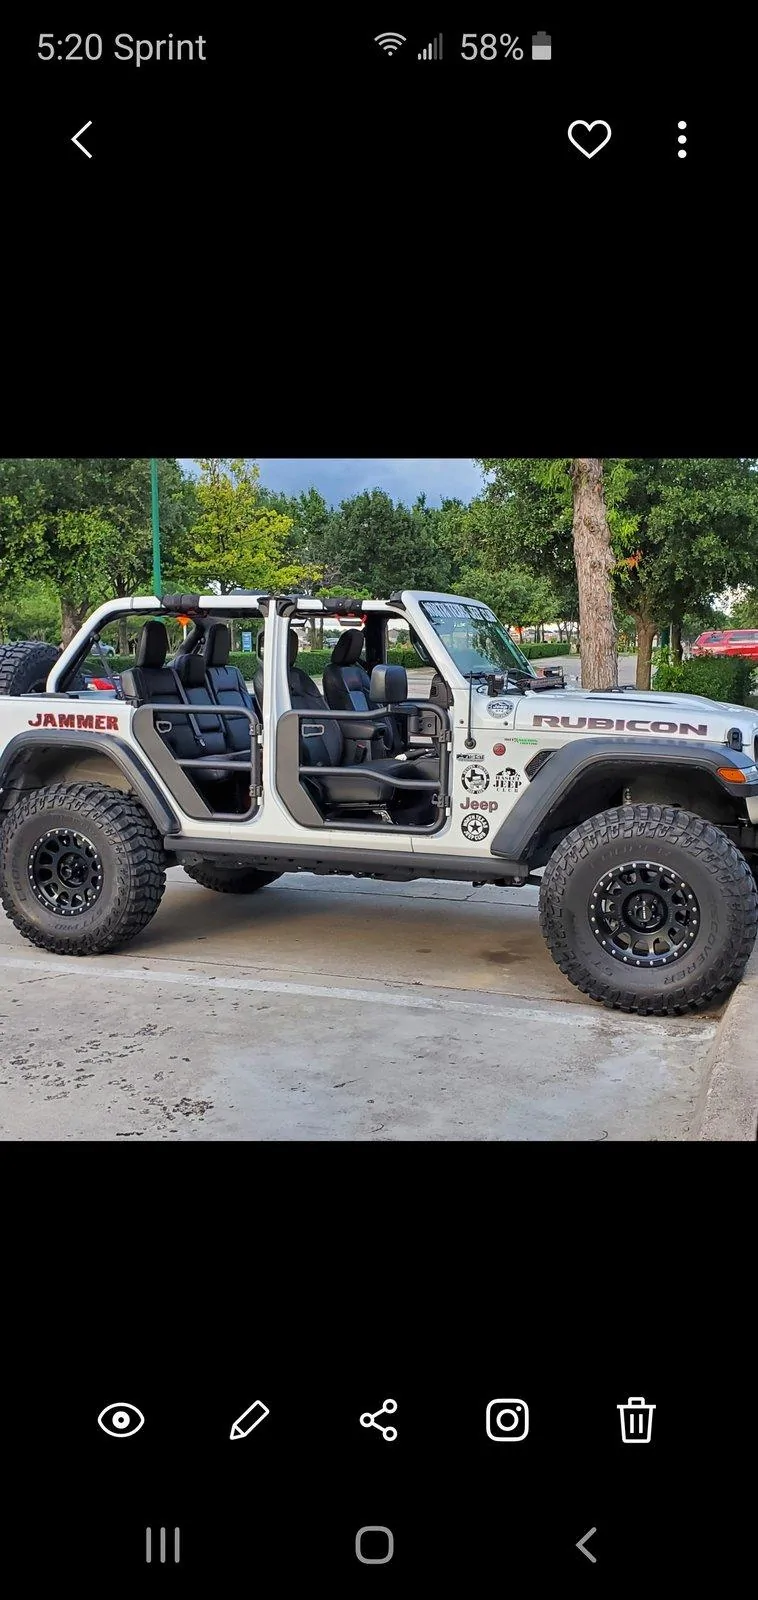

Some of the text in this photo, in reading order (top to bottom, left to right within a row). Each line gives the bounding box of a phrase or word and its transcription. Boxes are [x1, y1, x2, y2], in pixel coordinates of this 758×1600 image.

[28, 713, 119, 731] JAMMER
[532, 714, 708, 736] RUBICON
[493, 780, 522, 788] JEEP
[460, 797, 499, 813] Jeep
